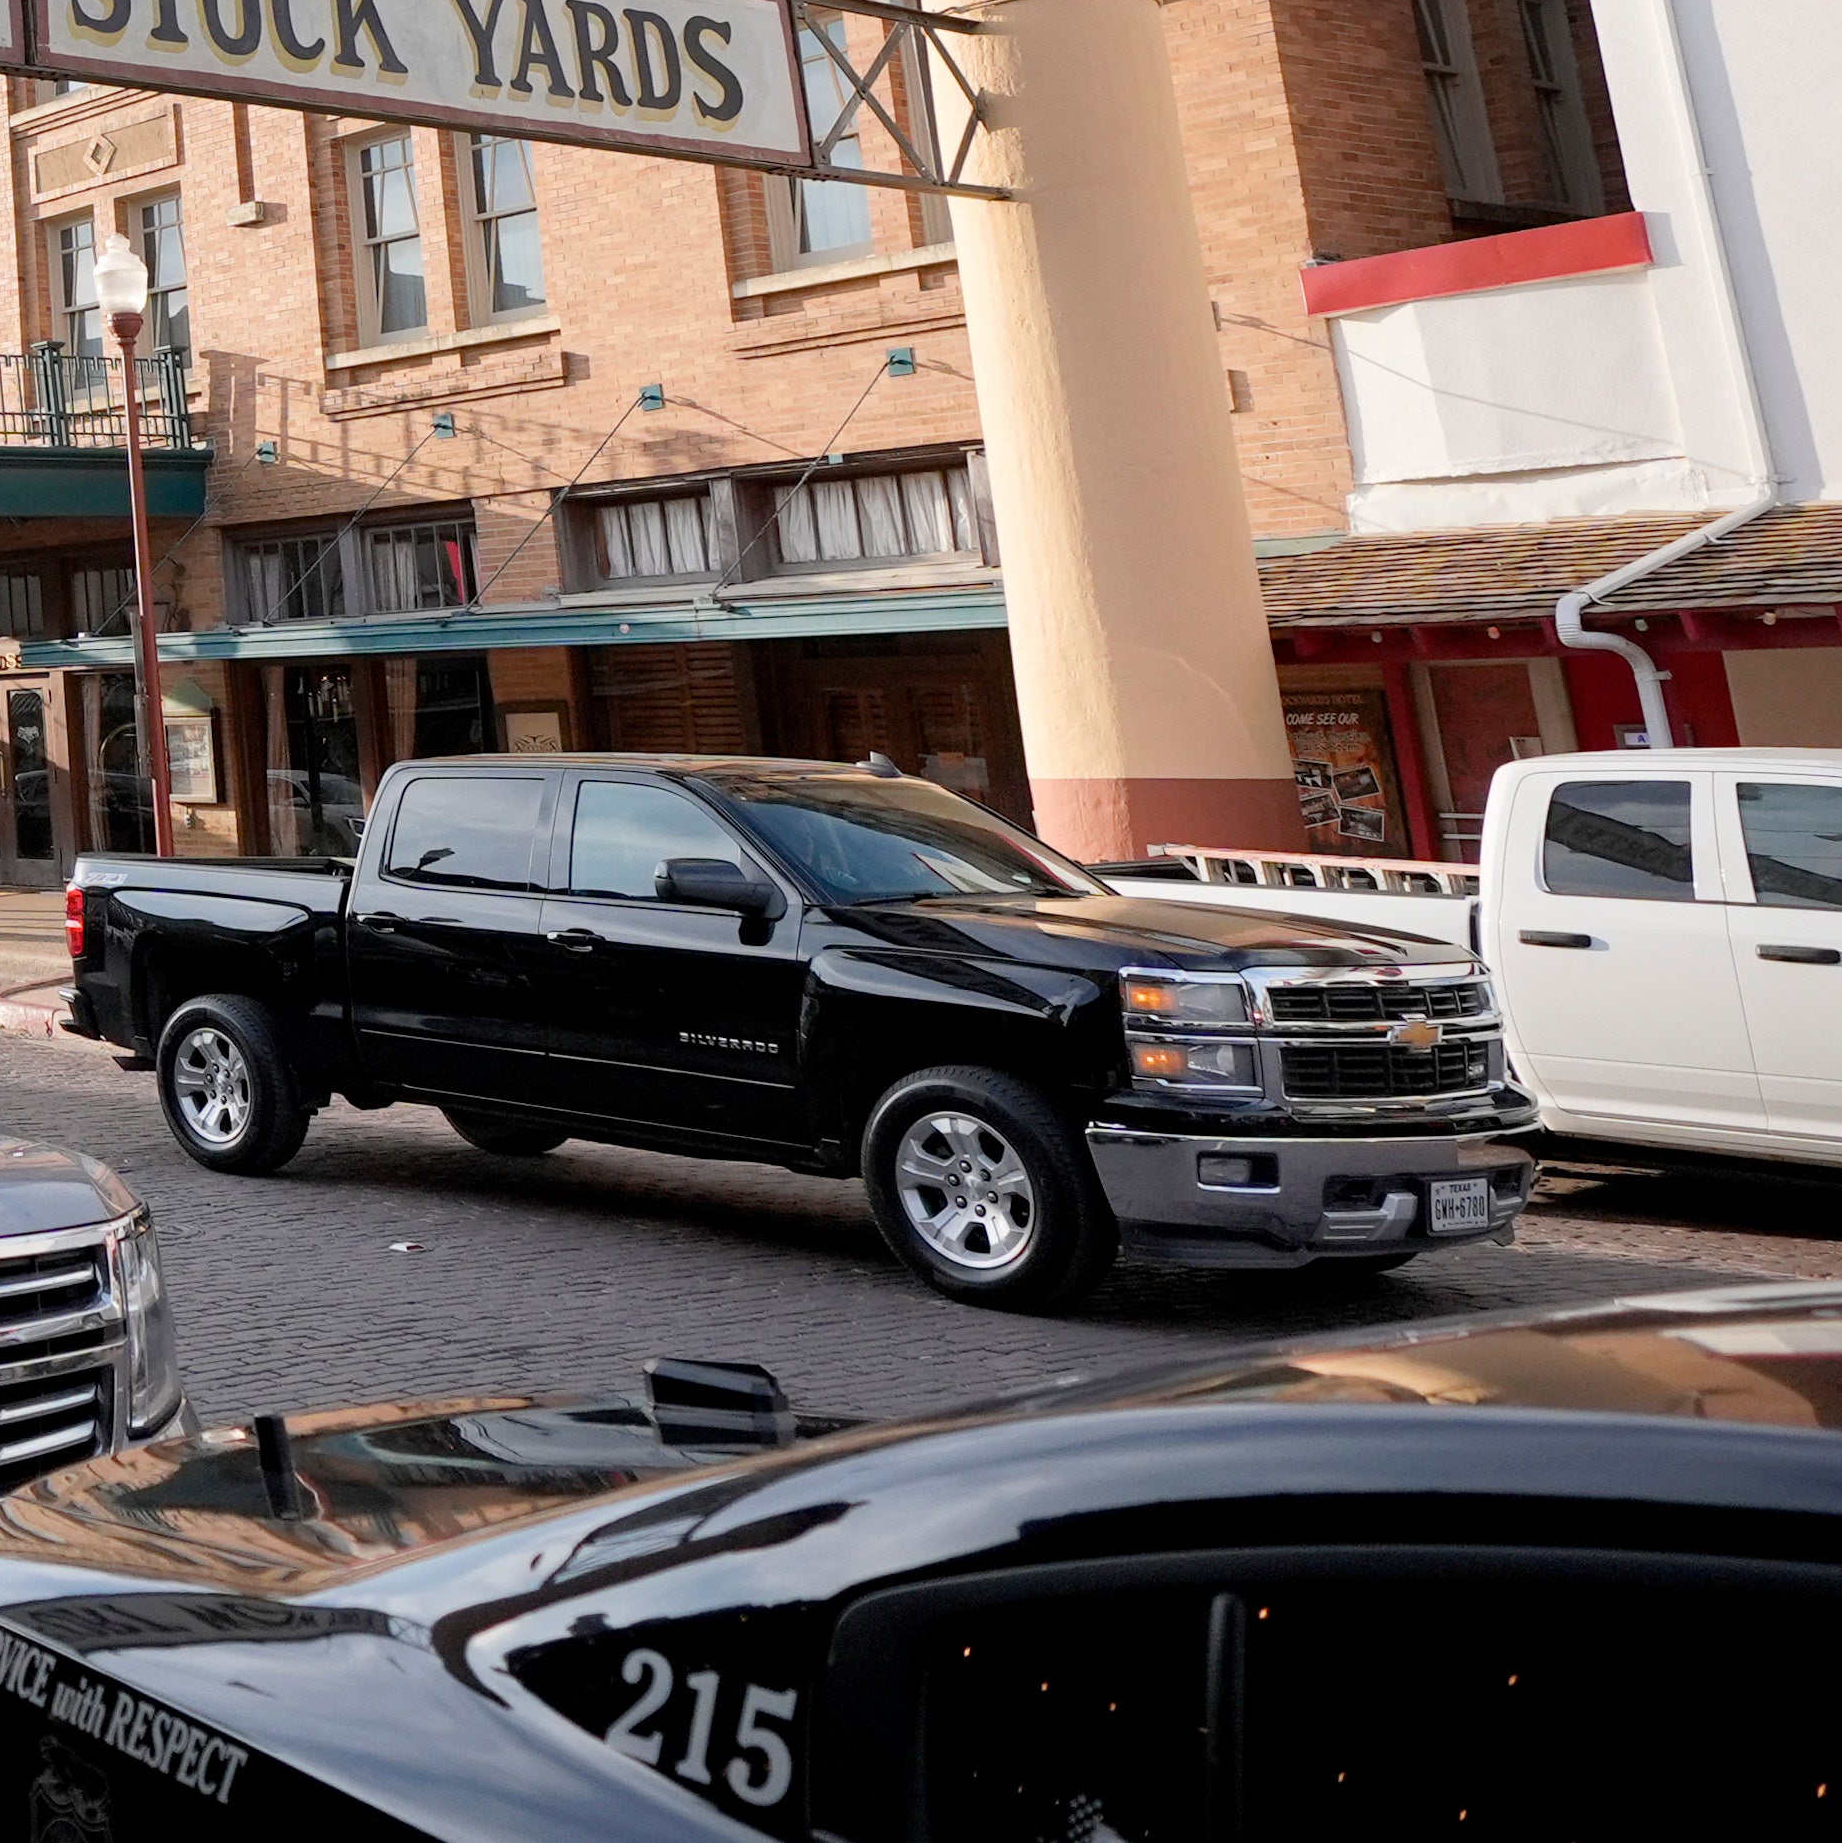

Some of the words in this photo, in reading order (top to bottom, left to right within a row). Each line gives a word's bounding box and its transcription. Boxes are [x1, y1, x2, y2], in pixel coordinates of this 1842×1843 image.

[1286, 712, 1315, 726] COME
[1315, 712, 1337, 725] SEE
[1338, 712, 1359, 725] OUR
[679, 1031, 779, 1054] SILVERADO
[51, 1675, 107, 1739] with
[104, 1689, 250, 1805] RESPECT
[604, 1647, 797, 1807] 215
